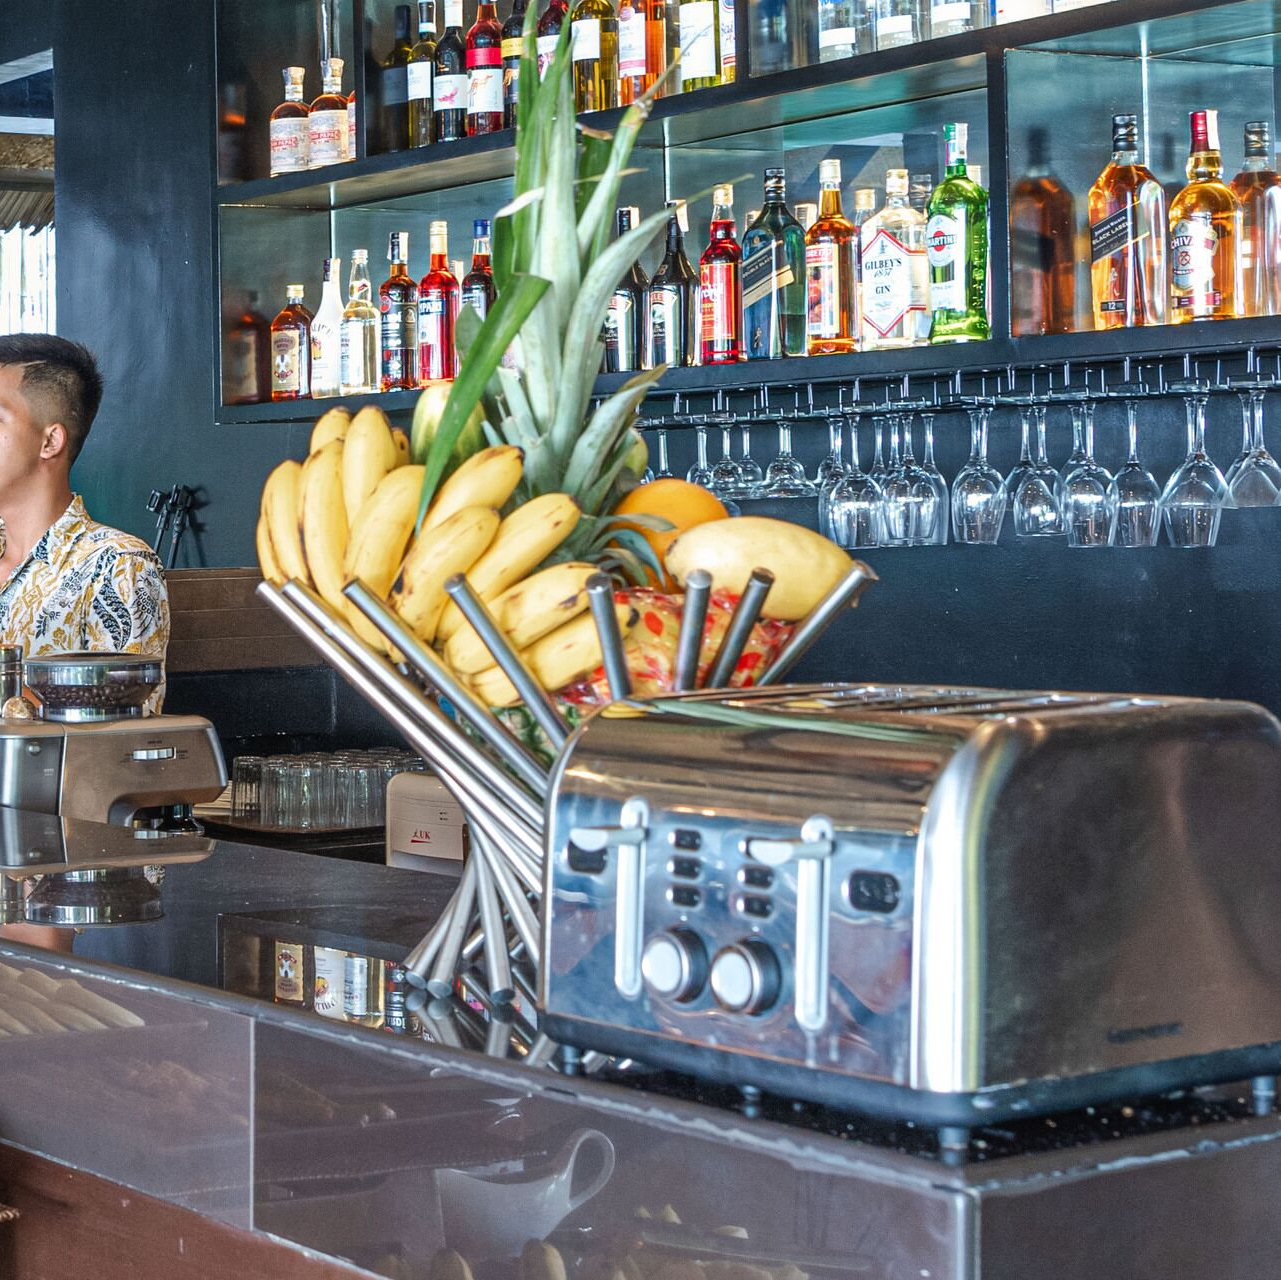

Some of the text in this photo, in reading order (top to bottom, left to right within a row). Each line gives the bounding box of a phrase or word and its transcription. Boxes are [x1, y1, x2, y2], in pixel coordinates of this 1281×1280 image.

[865, 258, 902, 271] GILBEY'S
[875, 285, 891, 294] GIN
[1108, 302, 1116, 310] 12
